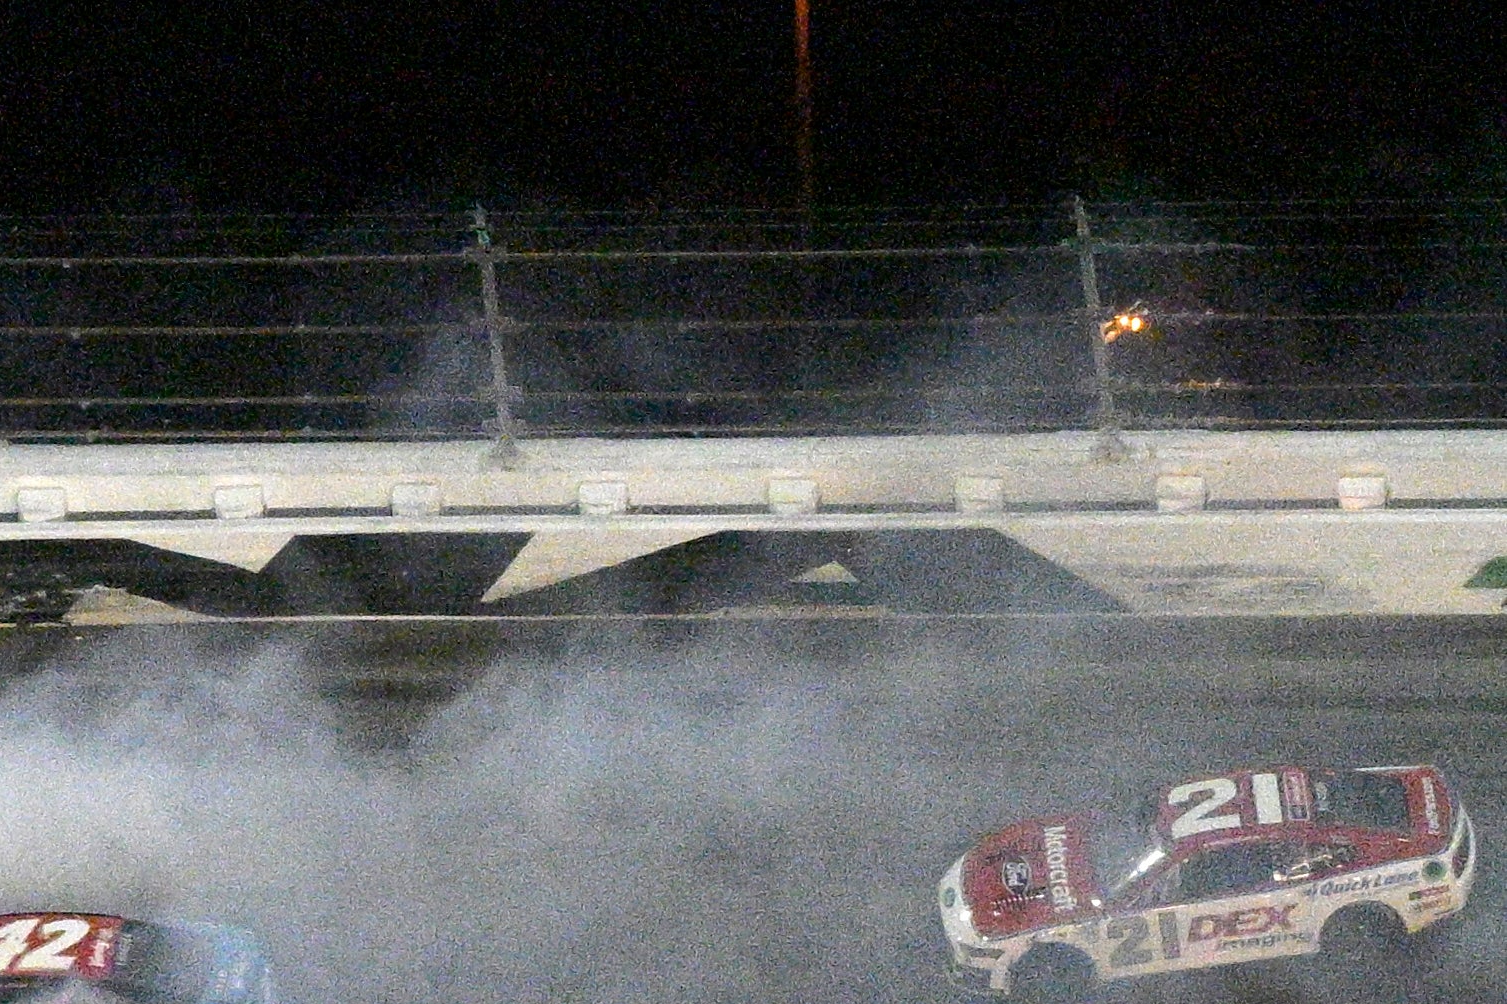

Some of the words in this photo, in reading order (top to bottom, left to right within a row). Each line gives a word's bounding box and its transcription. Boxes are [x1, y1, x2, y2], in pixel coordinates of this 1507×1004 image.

[1167, 773, 1283, 839] 21
[1044, 825, 1078, 912] Motorcraft
[1319, 876, 1371, 897] Quick
[1373, 870, 1420, 888] Lane
[1106, 911, 1181, 968] 21
[1188, 904, 1298, 942] DEX
